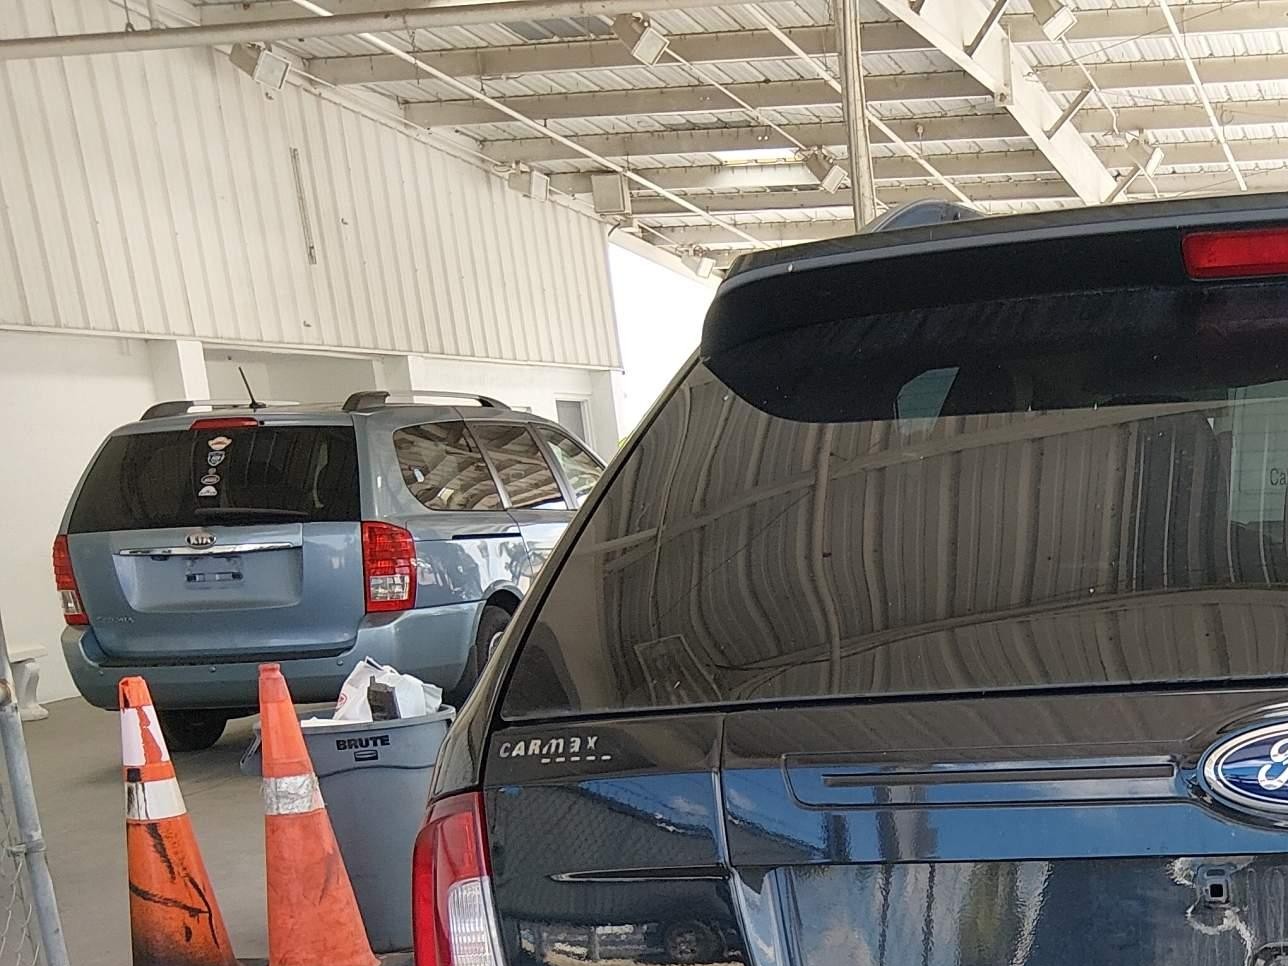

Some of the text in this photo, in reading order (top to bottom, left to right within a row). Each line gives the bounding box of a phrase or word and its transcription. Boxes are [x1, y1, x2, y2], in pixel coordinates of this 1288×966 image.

[1270, 467, 1287, 486] Ca
[190, 535, 211, 546] KIA
[336, 735, 390, 751] BRUTE
